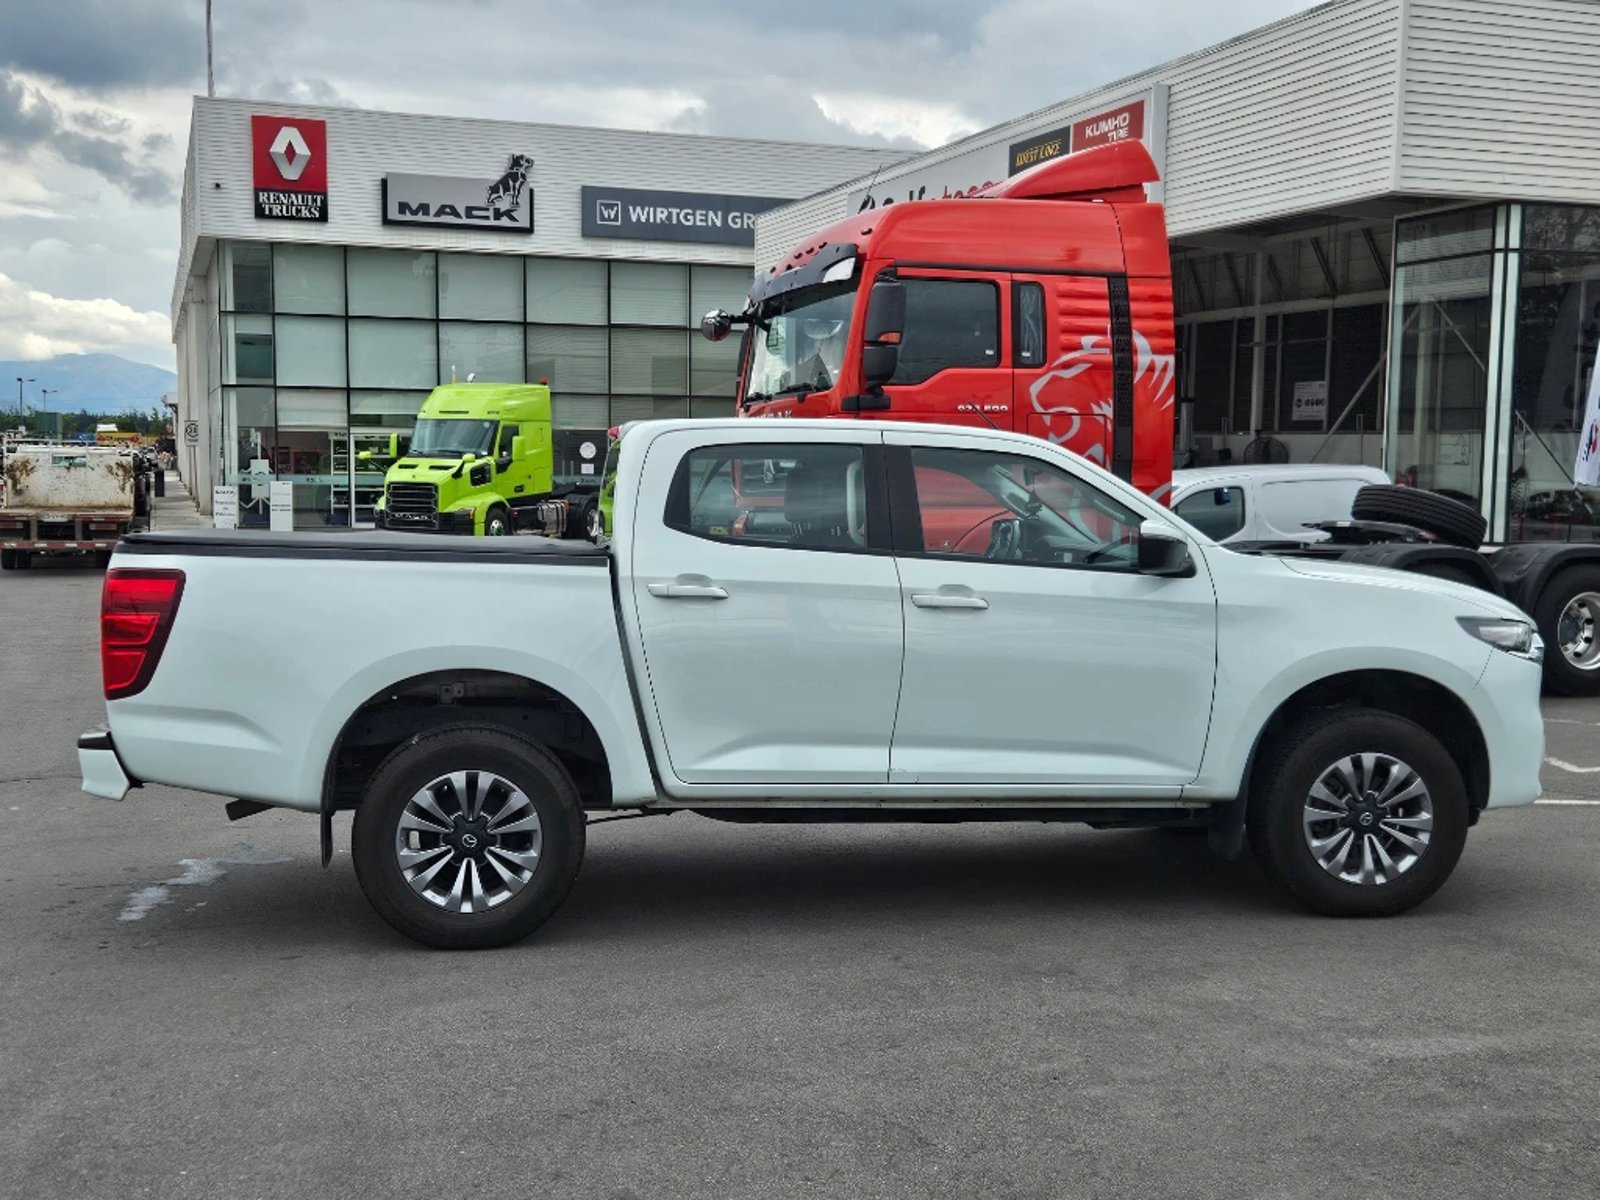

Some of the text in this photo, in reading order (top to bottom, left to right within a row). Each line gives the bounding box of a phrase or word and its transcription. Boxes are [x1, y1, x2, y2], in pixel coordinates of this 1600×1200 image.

[1085, 112, 1129, 138] KUMHO
[1107, 127, 1129, 142] TIRE
[259, 191, 324, 207] RENAULT
[262, 204, 320, 218] TRUCKS
[397, 200, 520, 223] MACK
[628, 205, 722, 228] WIRTGEN
